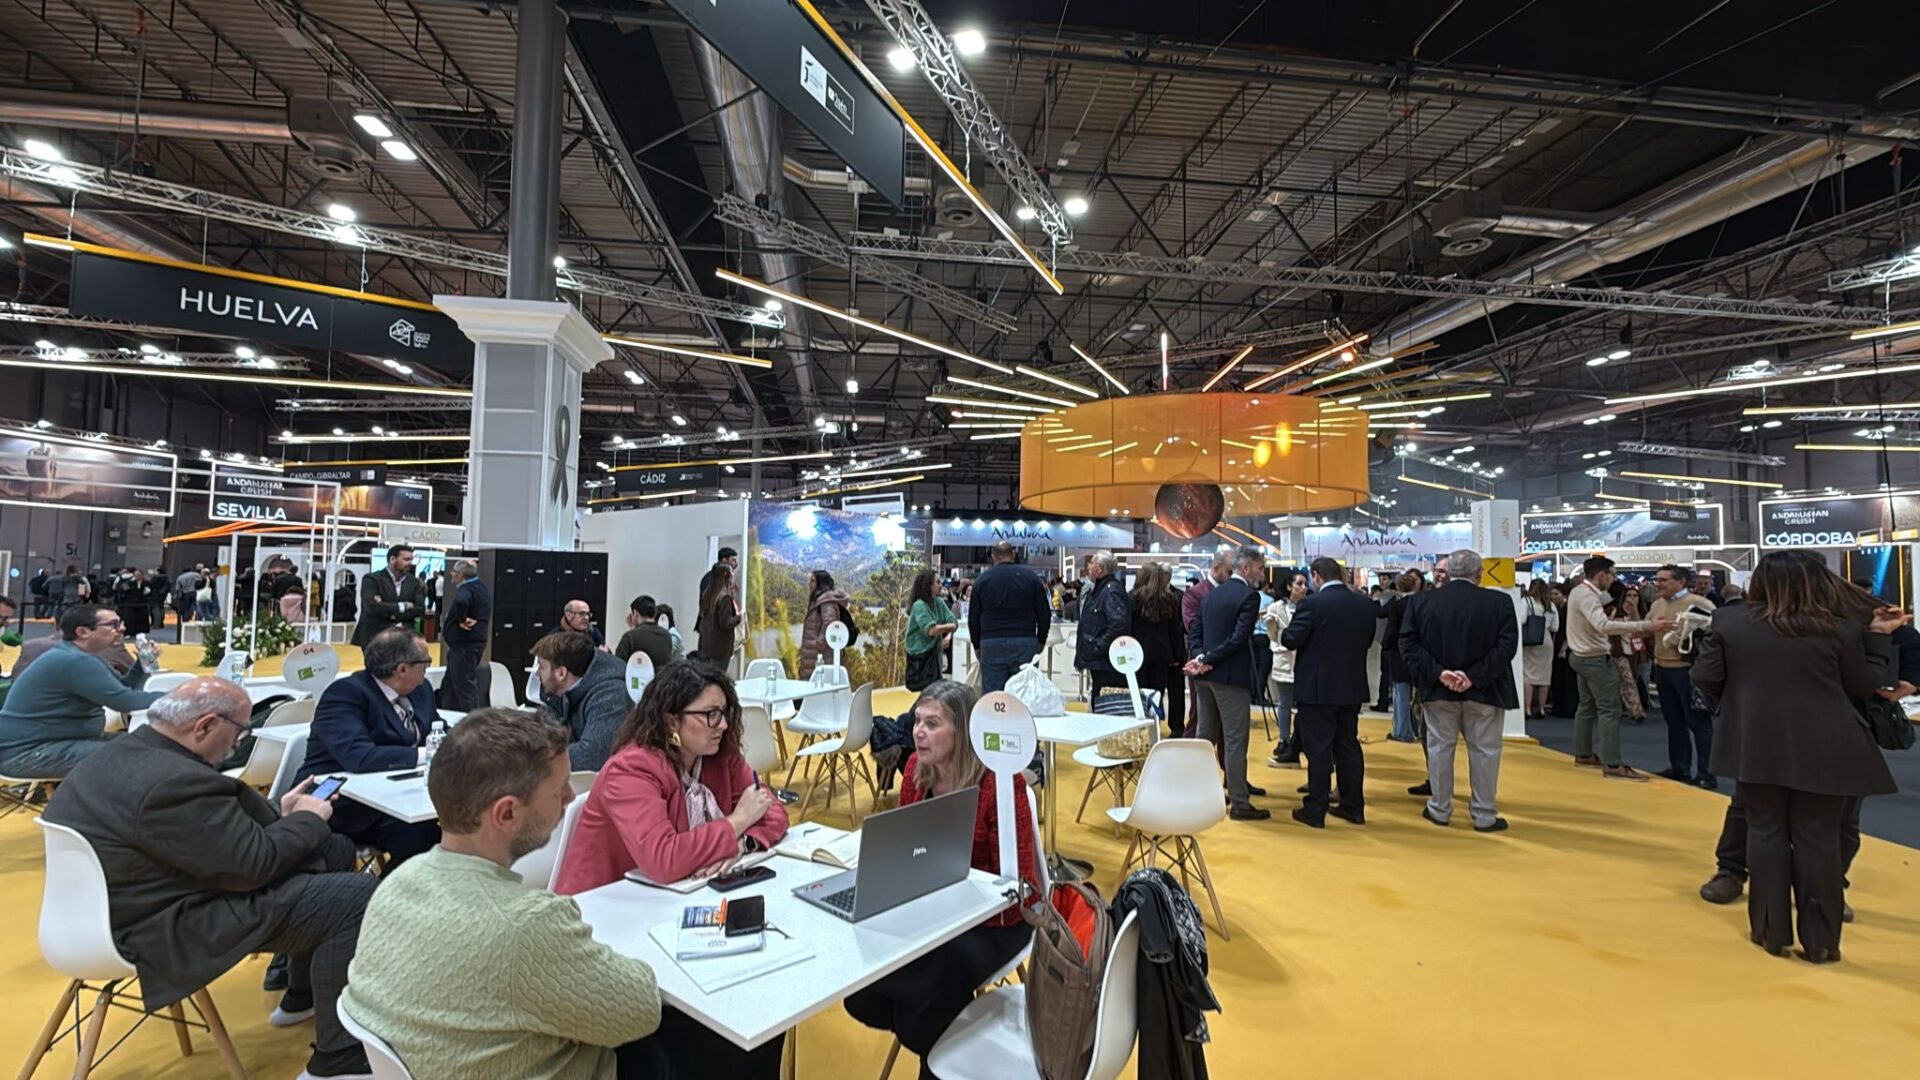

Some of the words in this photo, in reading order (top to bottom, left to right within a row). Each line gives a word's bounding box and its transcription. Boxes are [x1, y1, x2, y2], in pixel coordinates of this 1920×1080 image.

[180, 287, 318, 330] HUELVA
[640, 472, 667, 484] CÁDIZ
[216, 502, 287, 520] SEVILLA
[412, 528, 441, 541] CÁDIZ
[1765, 531, 1856, 545] CÓRDOBA
[1525, 540, 1562, 550] COSTA
[1563, 540, 1584, 549] DEL
[1586, 540, 1606, 549] SOL
[303, 647, 315, 656] 04
[994, 702, 1006, 713] 02
